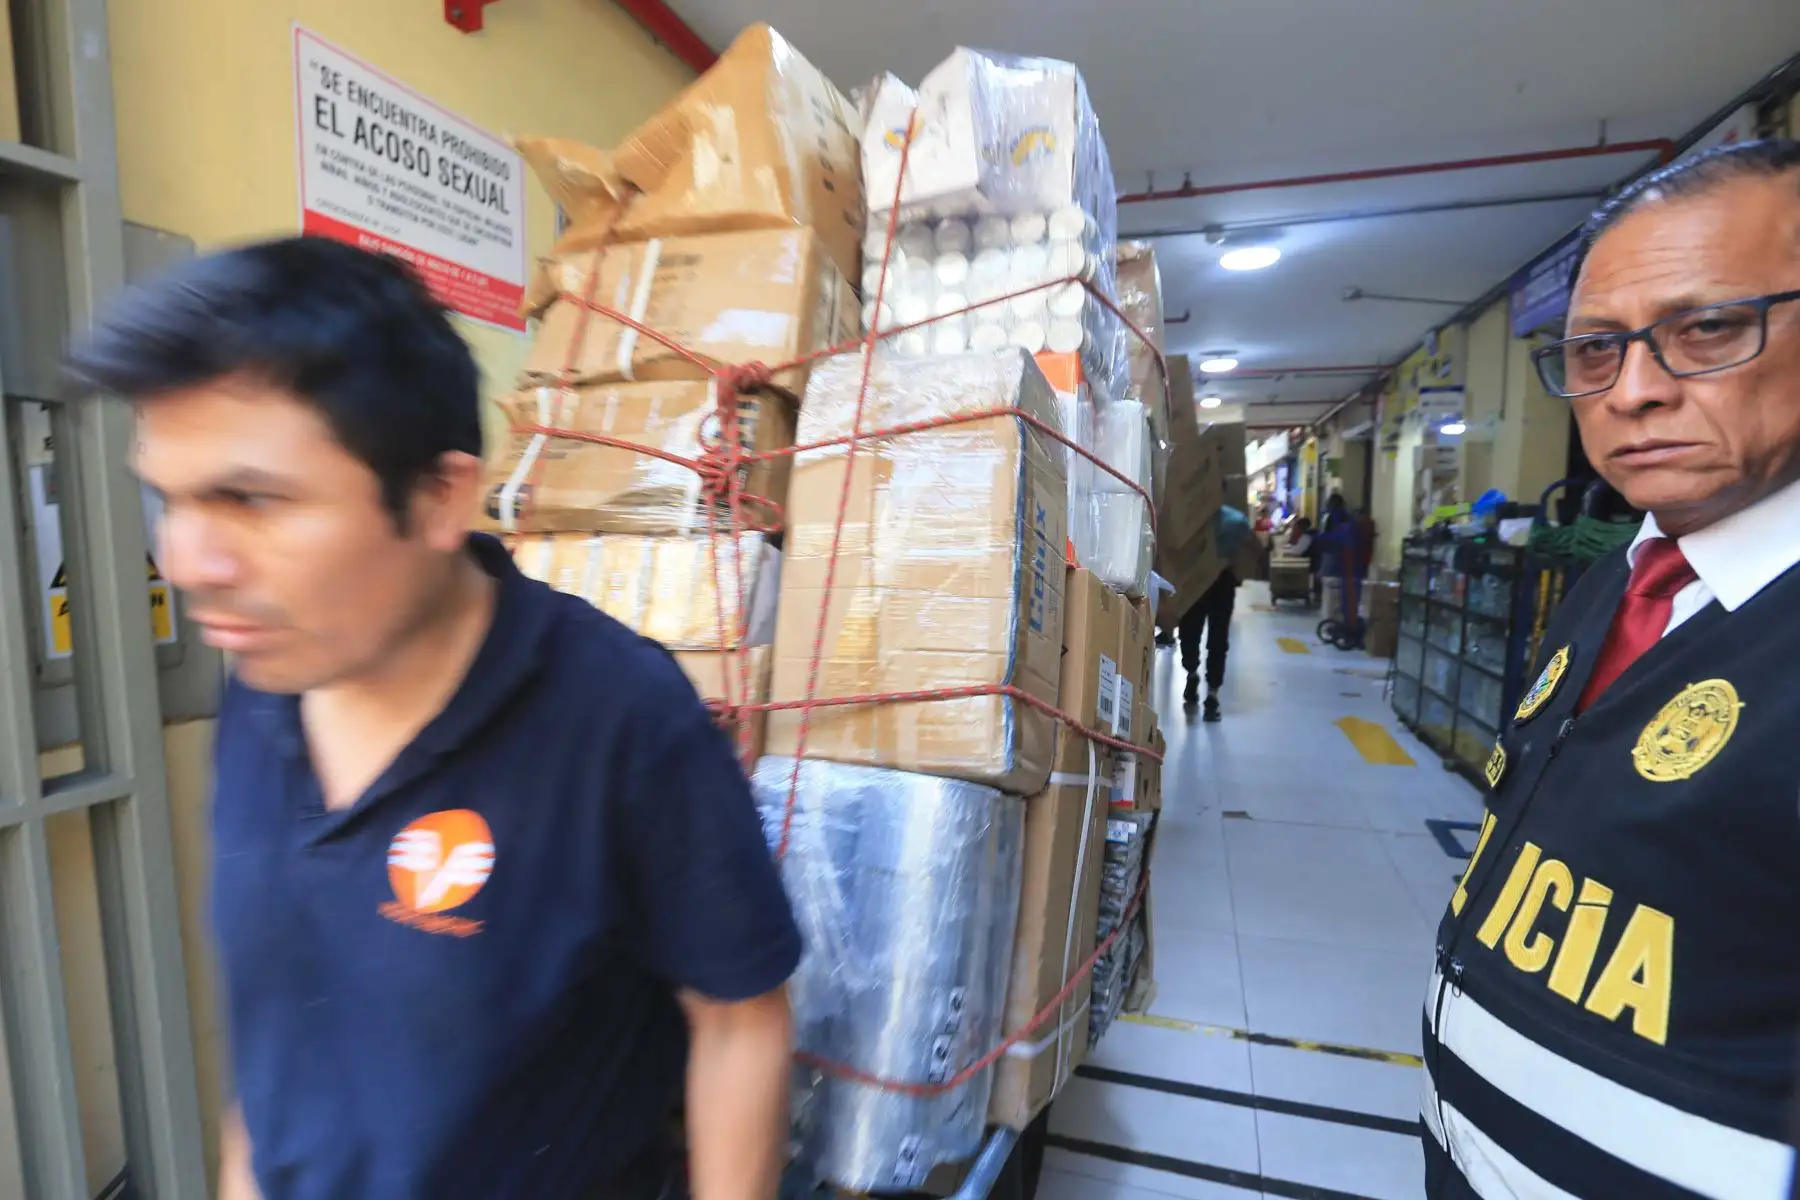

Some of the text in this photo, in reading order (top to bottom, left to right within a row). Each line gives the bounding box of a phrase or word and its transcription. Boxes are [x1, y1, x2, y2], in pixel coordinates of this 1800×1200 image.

[313, 92, 346, 139] EL
[353, 115, 429, 178] ACOSO
[438, 155, 510, 215] SEXUAL
[347, 79, 438, 147] ENCUENTRA
[441, 129, 510, 181] PROHIBIDO
